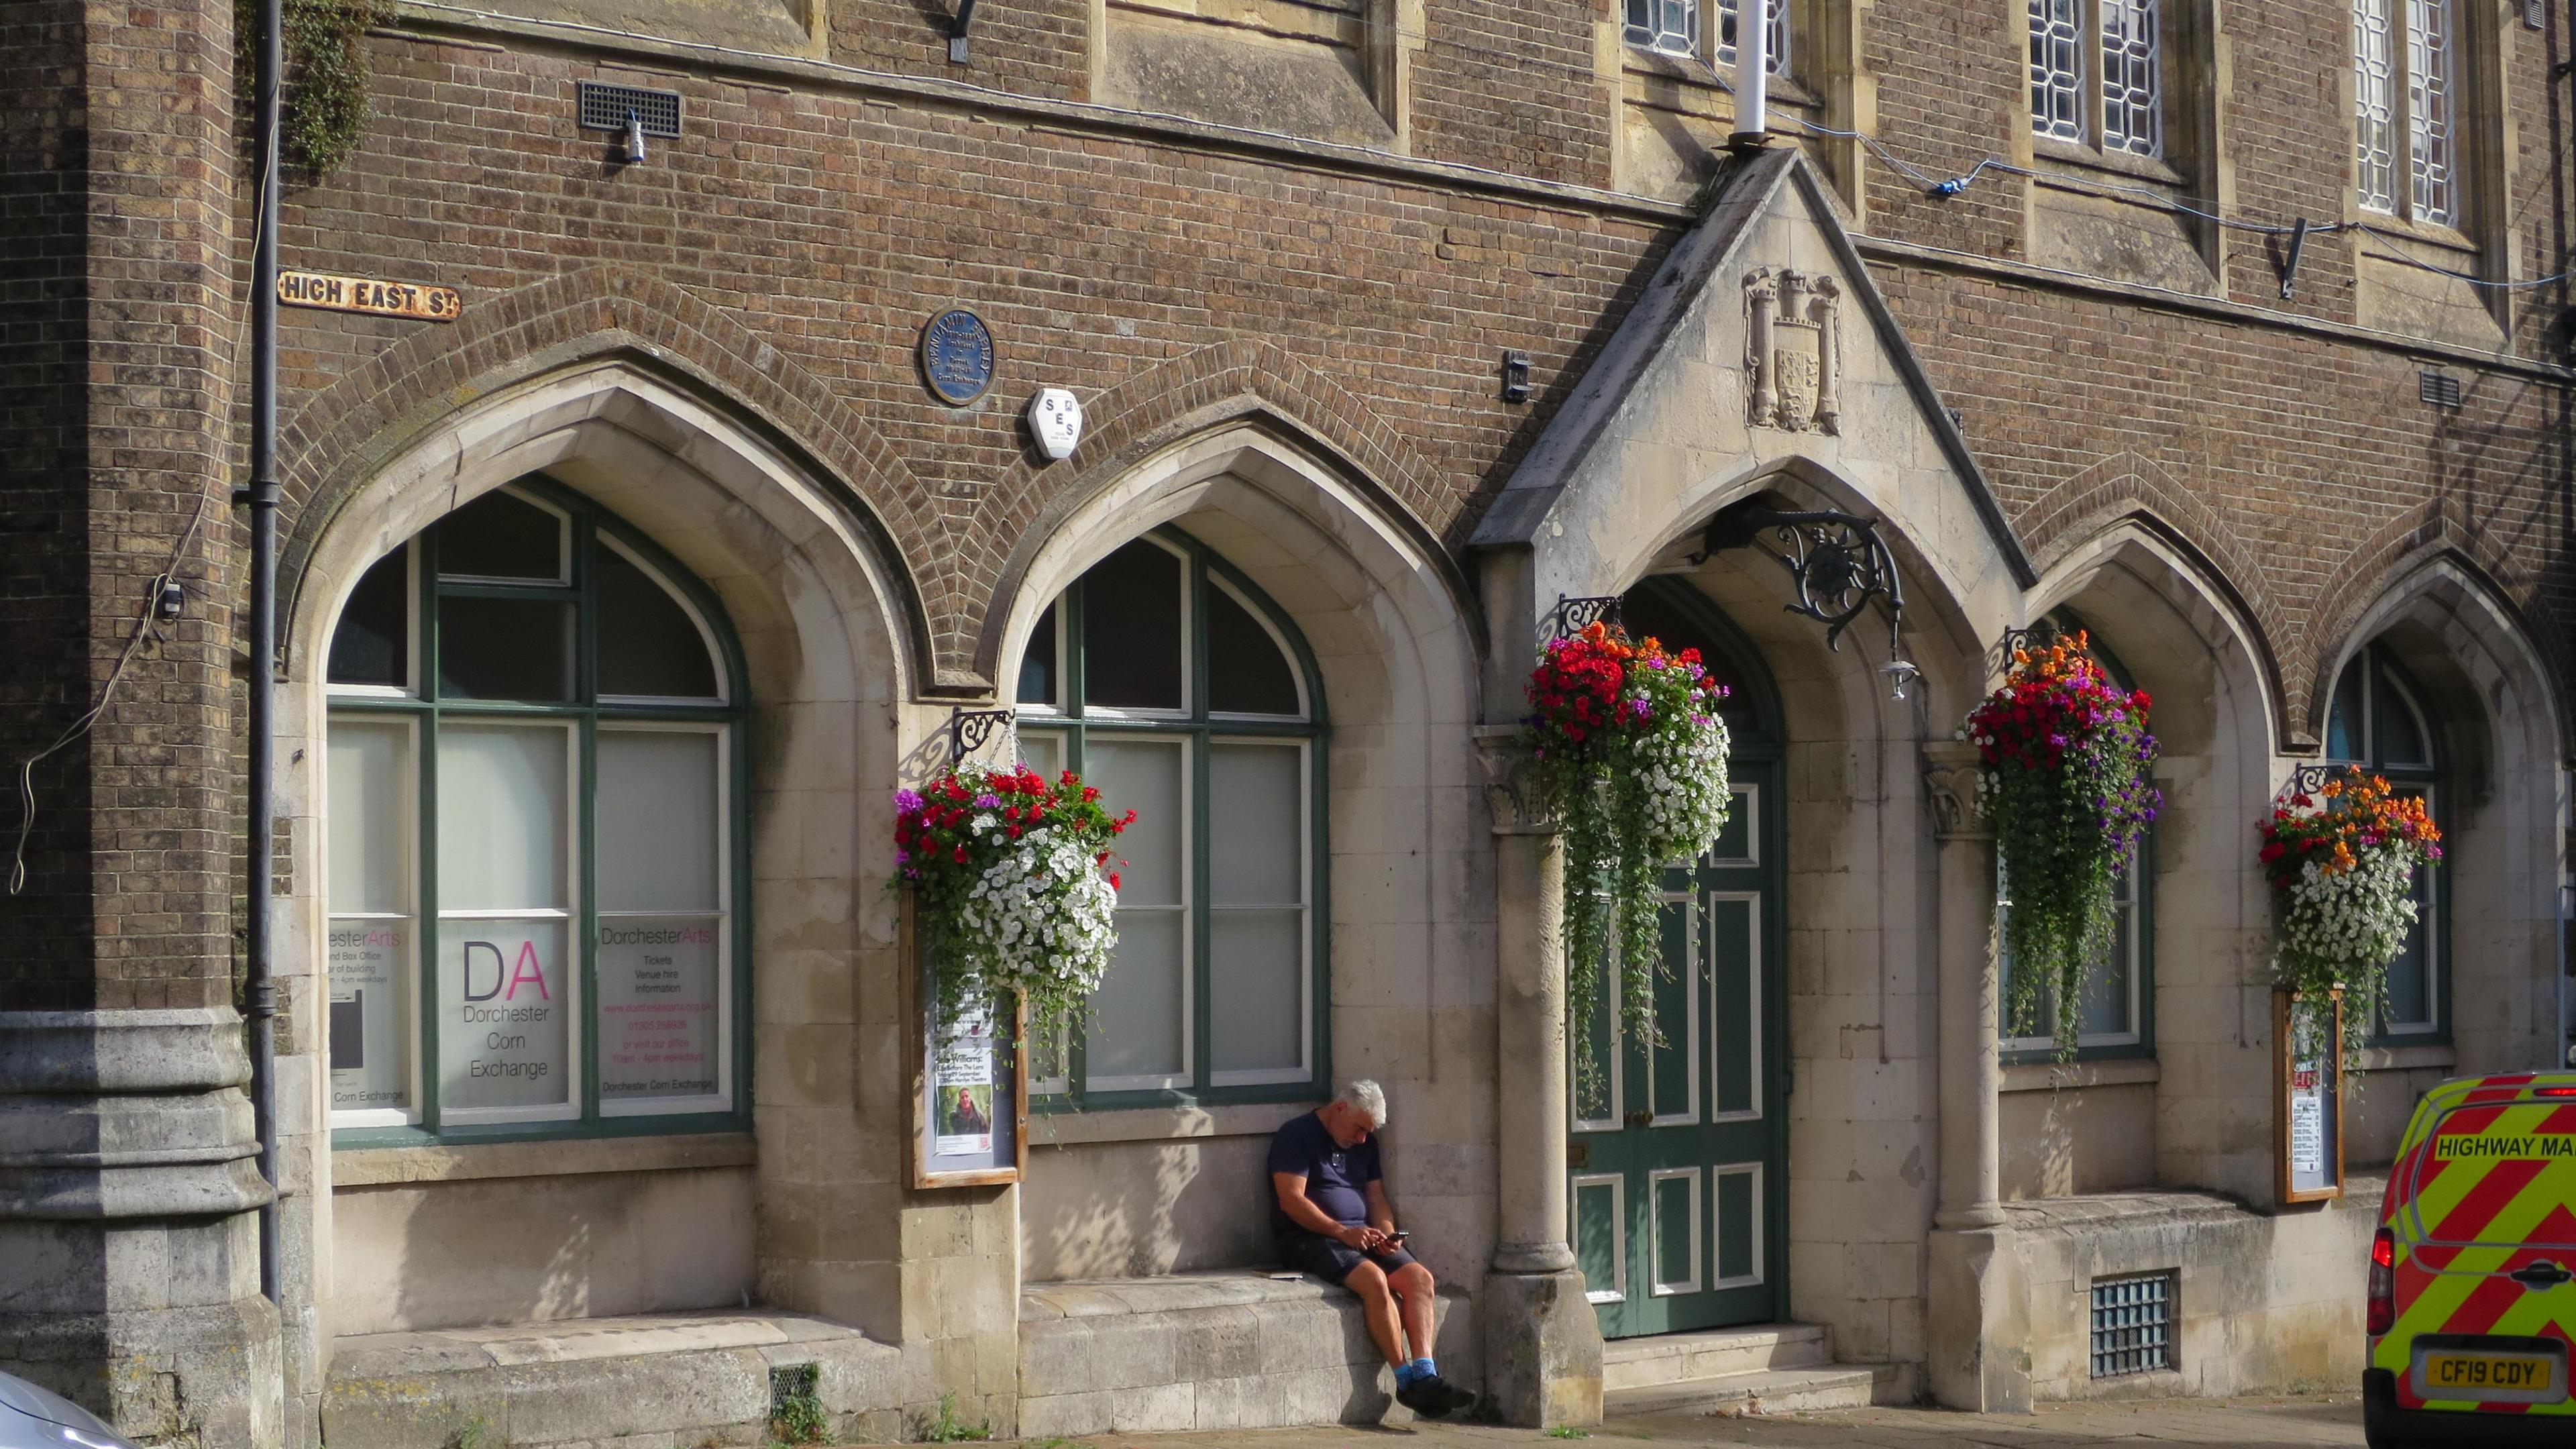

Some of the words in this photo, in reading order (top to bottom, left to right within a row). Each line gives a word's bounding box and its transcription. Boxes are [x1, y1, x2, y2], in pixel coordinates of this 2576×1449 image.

[284, 276, 341, 303] HIGH
[355, 283, 416, 311] EAST
[602, 927, 712, 945] DorchesterArts
[342, 952, 358, 960] Box
[360, 951, 381, 960] Office
[644, 955, 672, 965] Tickets
[337, 965, 344, 973] of
[346, 965, 376, 975] building
[464, 941, 549, 1002] DA
[635, 970, 661, 979] Venue
[663, 969, 678, 979] hire
[341, 977, 354, 985] 4pm
[356, 976, 388, 985] weekdays
[635, 983, 682, 993] Information
[464, 1005, 549, 1024] Dorchester
[487, 1032, 525, 1050] Corn
[667, 1038, 690, 1047] office
[471, 1059, 547, 1080] Exchange
[603, 1081, 648, 1092] Dorchester
[649, 1081, 669, 1090] Corn
[672, 1079, 712, 1091] Exchange
[334, 1092, 356, 1102] Corn
[359, 1091, 404, 1102] Exchange
[2438, 1138, 2536, 1157] HIGHWAY
[2541, 1138, 2576, 1157] MA
[2441, 1360, 2487, 1383] CF19
[2493, 1362, 2536, 1385] CDY
